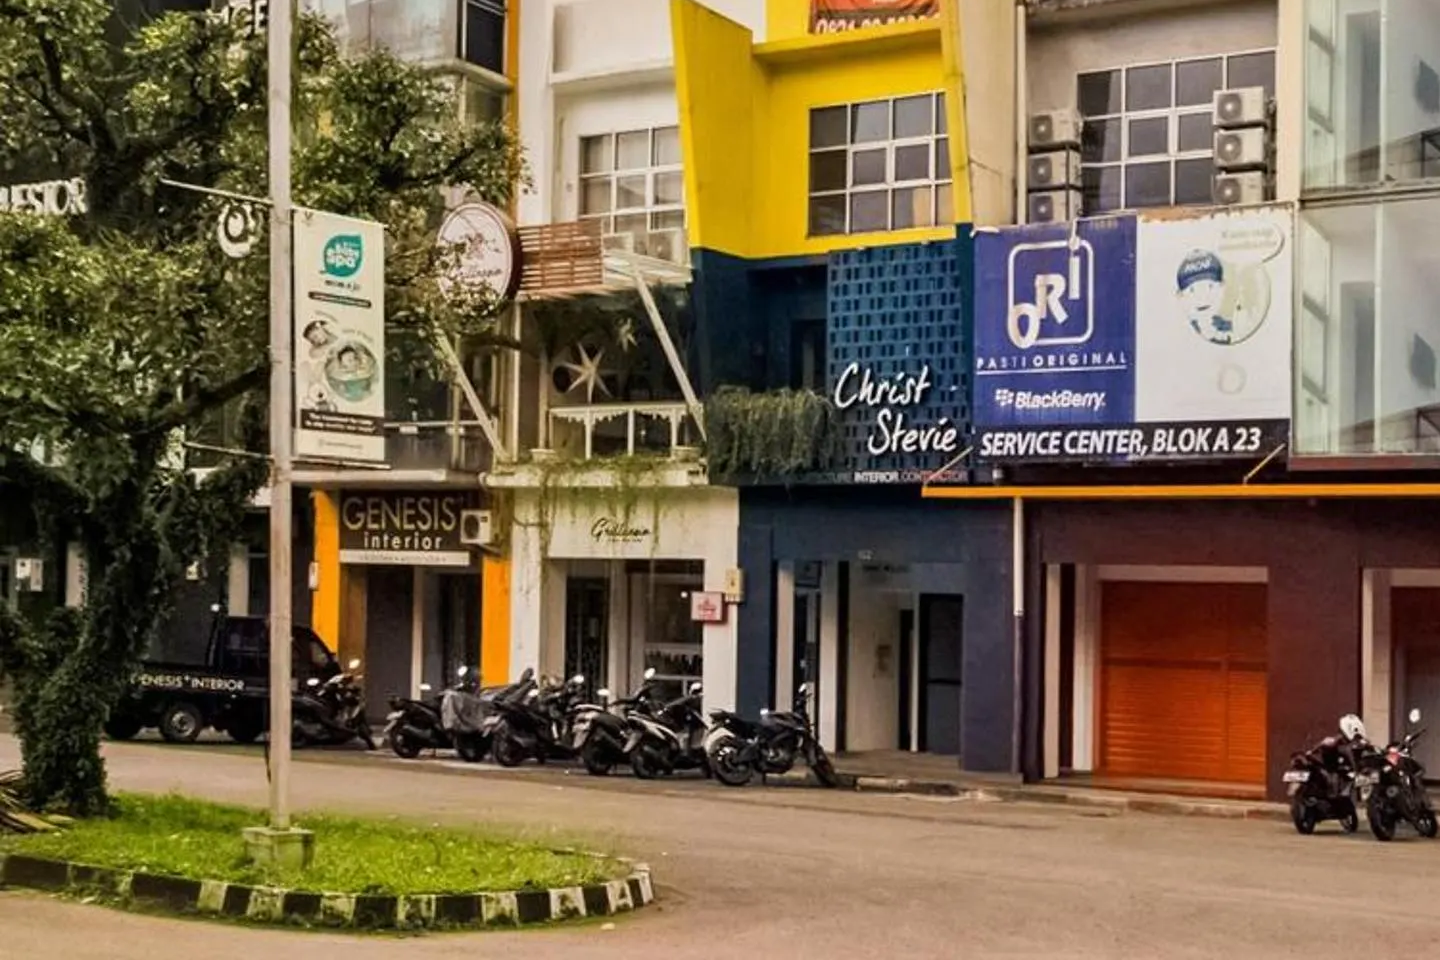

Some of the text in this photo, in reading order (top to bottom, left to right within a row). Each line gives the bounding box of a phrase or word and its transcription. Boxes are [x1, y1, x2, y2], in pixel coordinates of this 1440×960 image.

[976, 351, 1127, 369] PASTI ORIGINAL
[835, 362, 931, 408] Christ
[868, 408, 957, 455] Stevie
[980, 427, 1262, 456] SERVICE CENTER, BLOK A 23
[854, 471, 899, 483] INTERIOR
[364, 531, 442, 549] interior
[191, 677, 245, 691] INTERIOR
